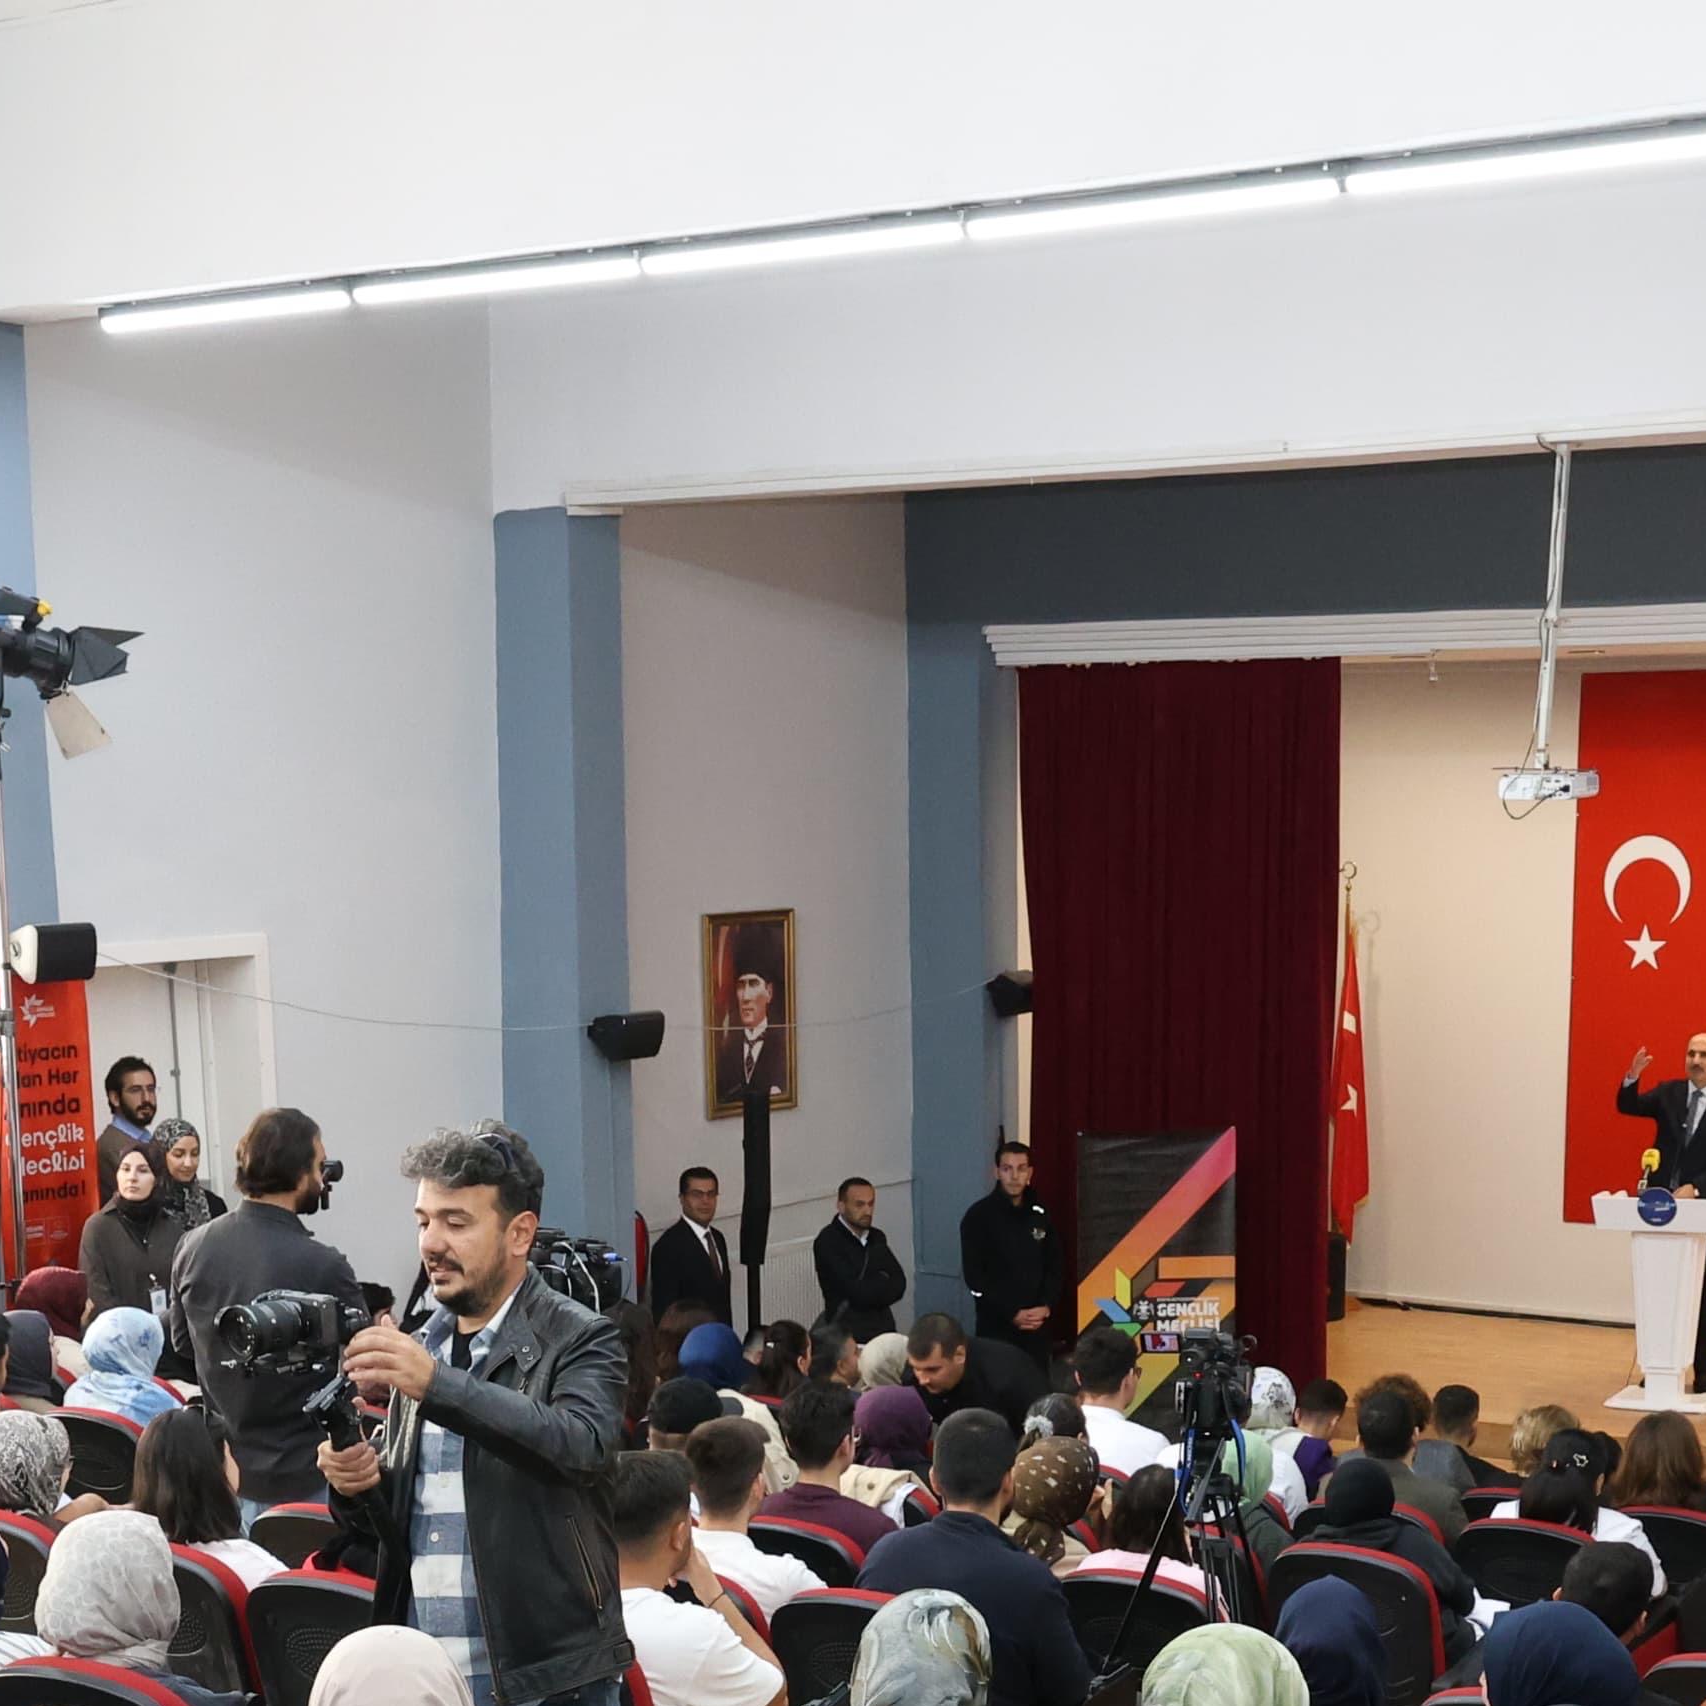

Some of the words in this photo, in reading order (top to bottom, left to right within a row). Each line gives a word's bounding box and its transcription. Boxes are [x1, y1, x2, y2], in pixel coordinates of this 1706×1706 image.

[17, 1042, 78, 1065] tiyacın
[16, 1071, 43, 1088] lan
[48, 1067, 79, 1086] Her
[19, 1093, 81, 1118] nında
[11, 1122, 85, 1150] ençlik
[20, 1148, 86, 1177] eclisi
